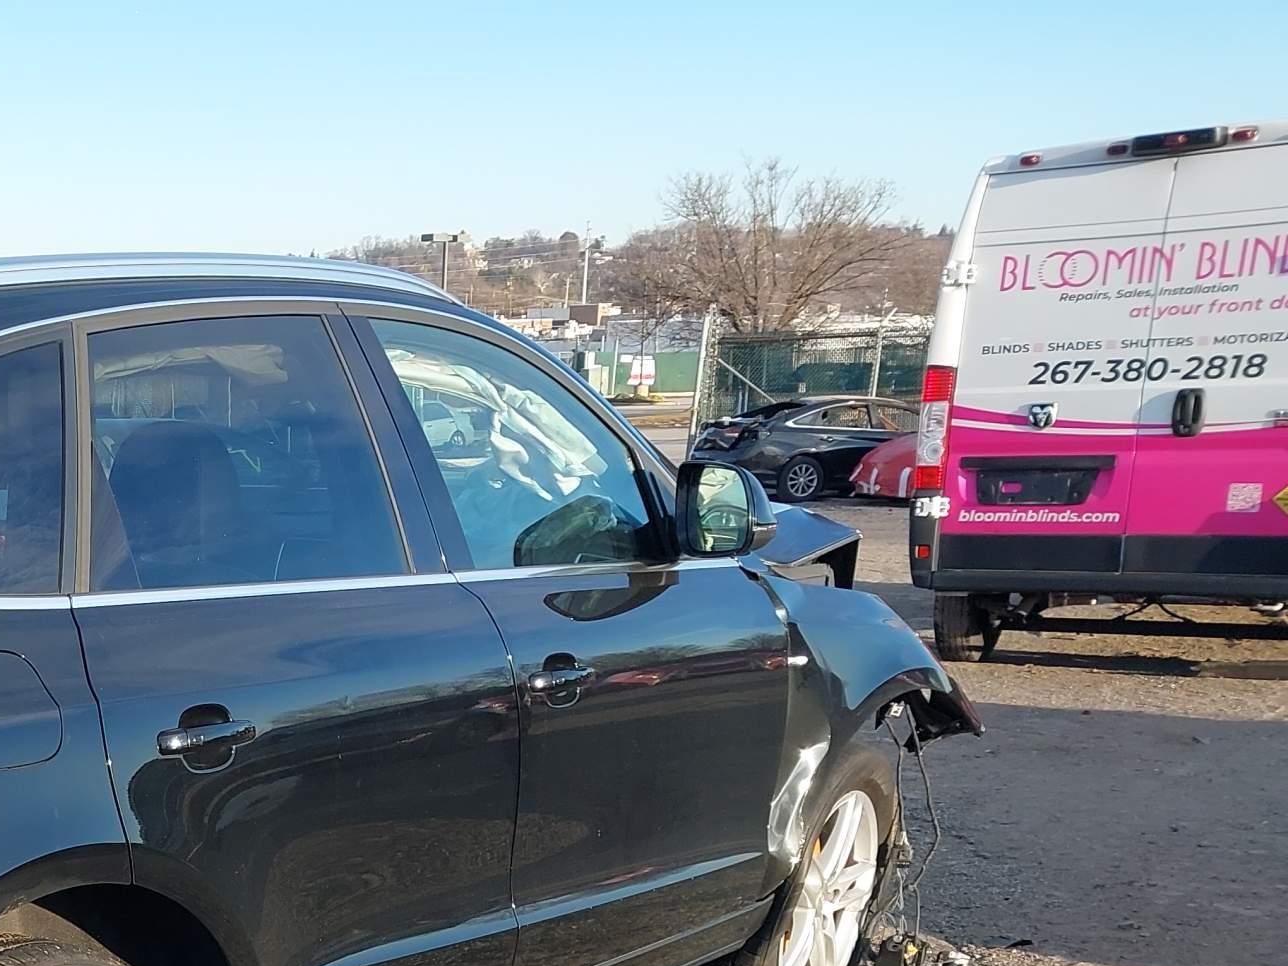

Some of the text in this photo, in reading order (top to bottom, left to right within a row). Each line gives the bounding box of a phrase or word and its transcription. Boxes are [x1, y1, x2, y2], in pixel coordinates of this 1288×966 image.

[1059, 282, 1239, 303] Repairs, Sales, Installation
[1129, 305, 1150, 318] at
[1152, 303, 1203, 321] your
[1208, 297, 1264, 314] front
[981, 343, 1030, 355] BLINDS
[1047, 340, 1102, 352] SHADES
[1120, 337, 1194, 349] SHUTTERS
[1028, 353, 1268, 386] 267-380-2818
[958, 509, 1121, 523] bloominblinds.com
